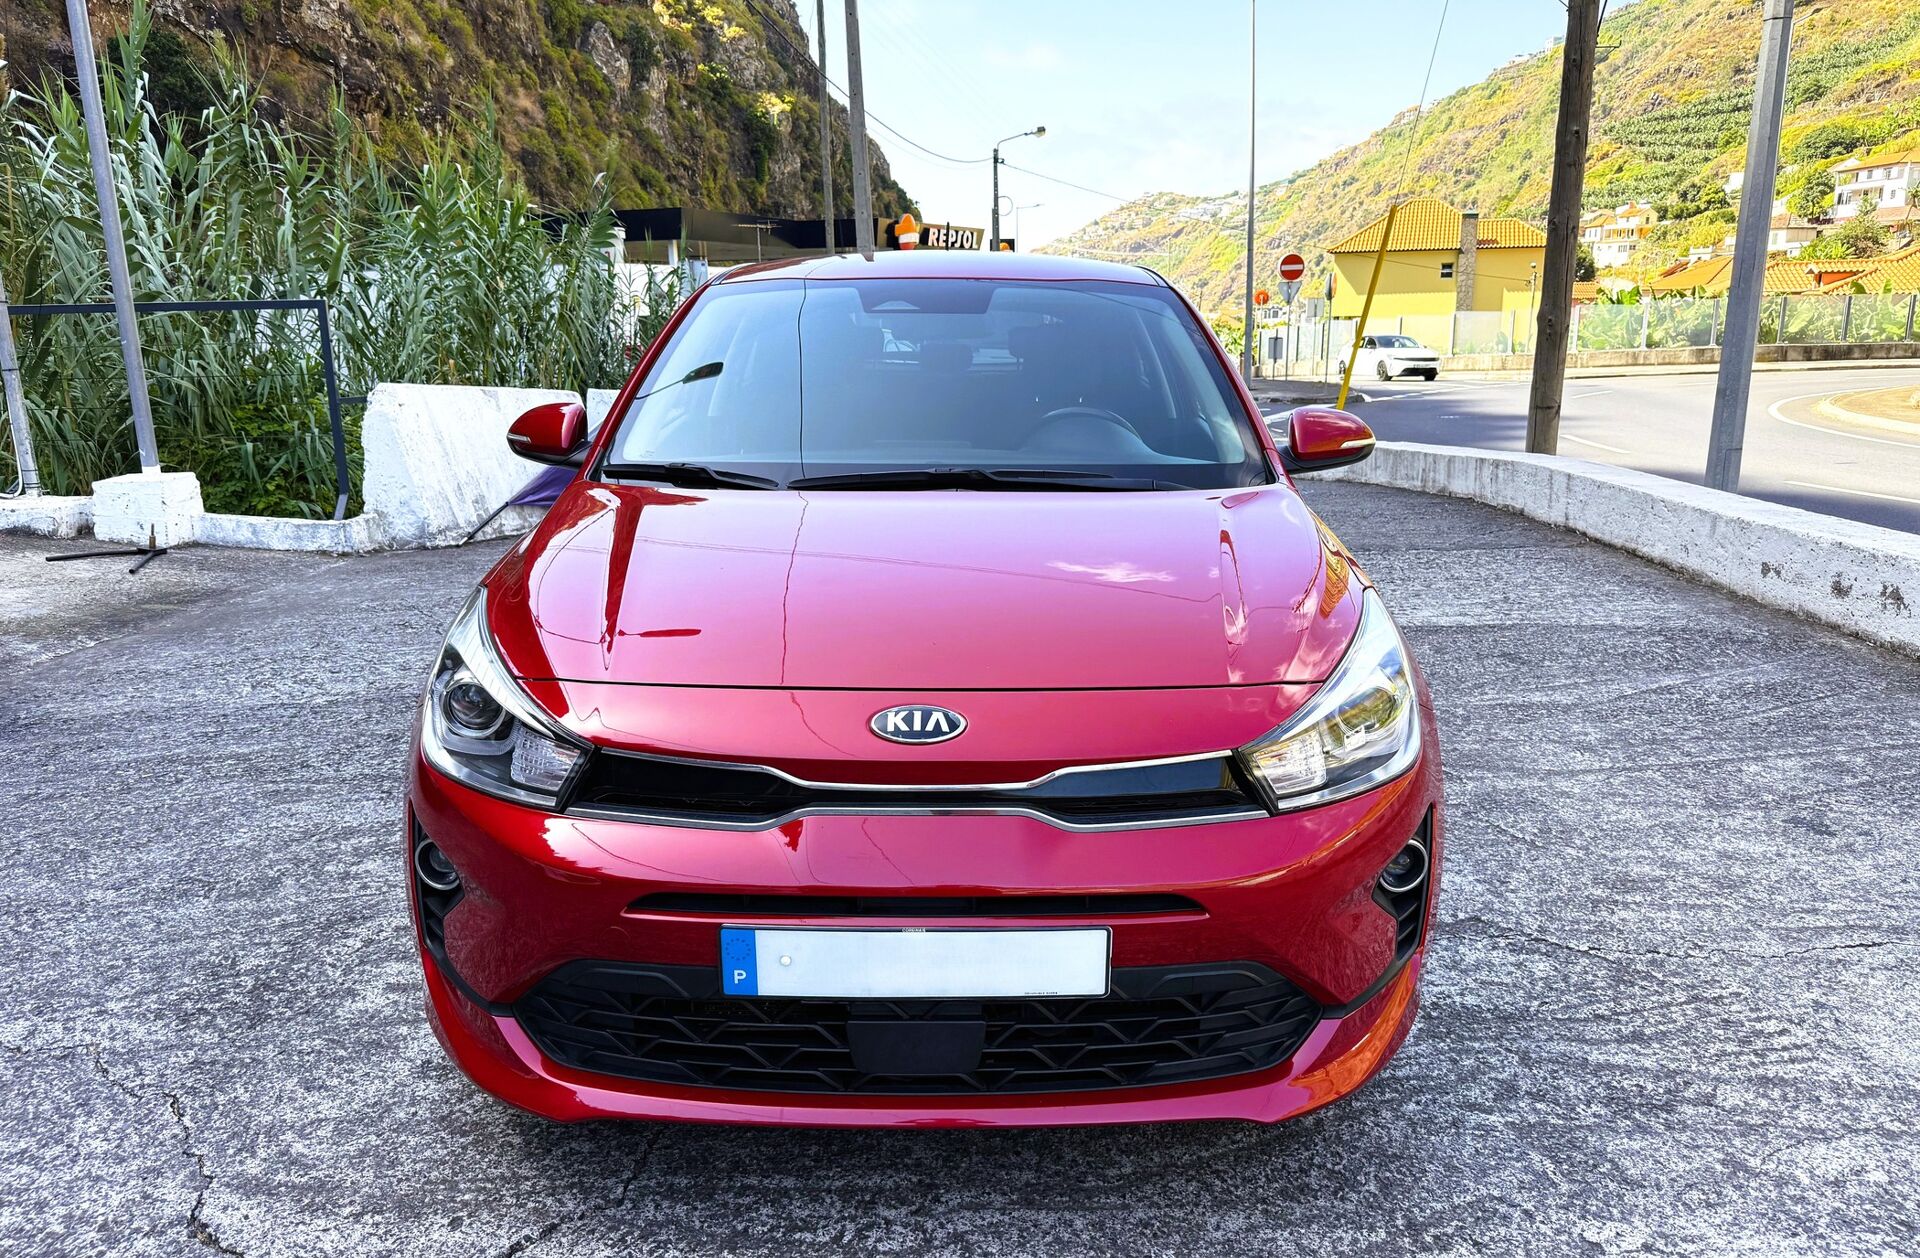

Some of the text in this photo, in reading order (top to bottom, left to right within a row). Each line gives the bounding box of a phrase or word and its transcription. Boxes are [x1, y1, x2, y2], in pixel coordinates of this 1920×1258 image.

[928, 227, 978, 249] REPSOL
[886, 710, 950, 733] KIA
[733, 969, 747, 984] P
